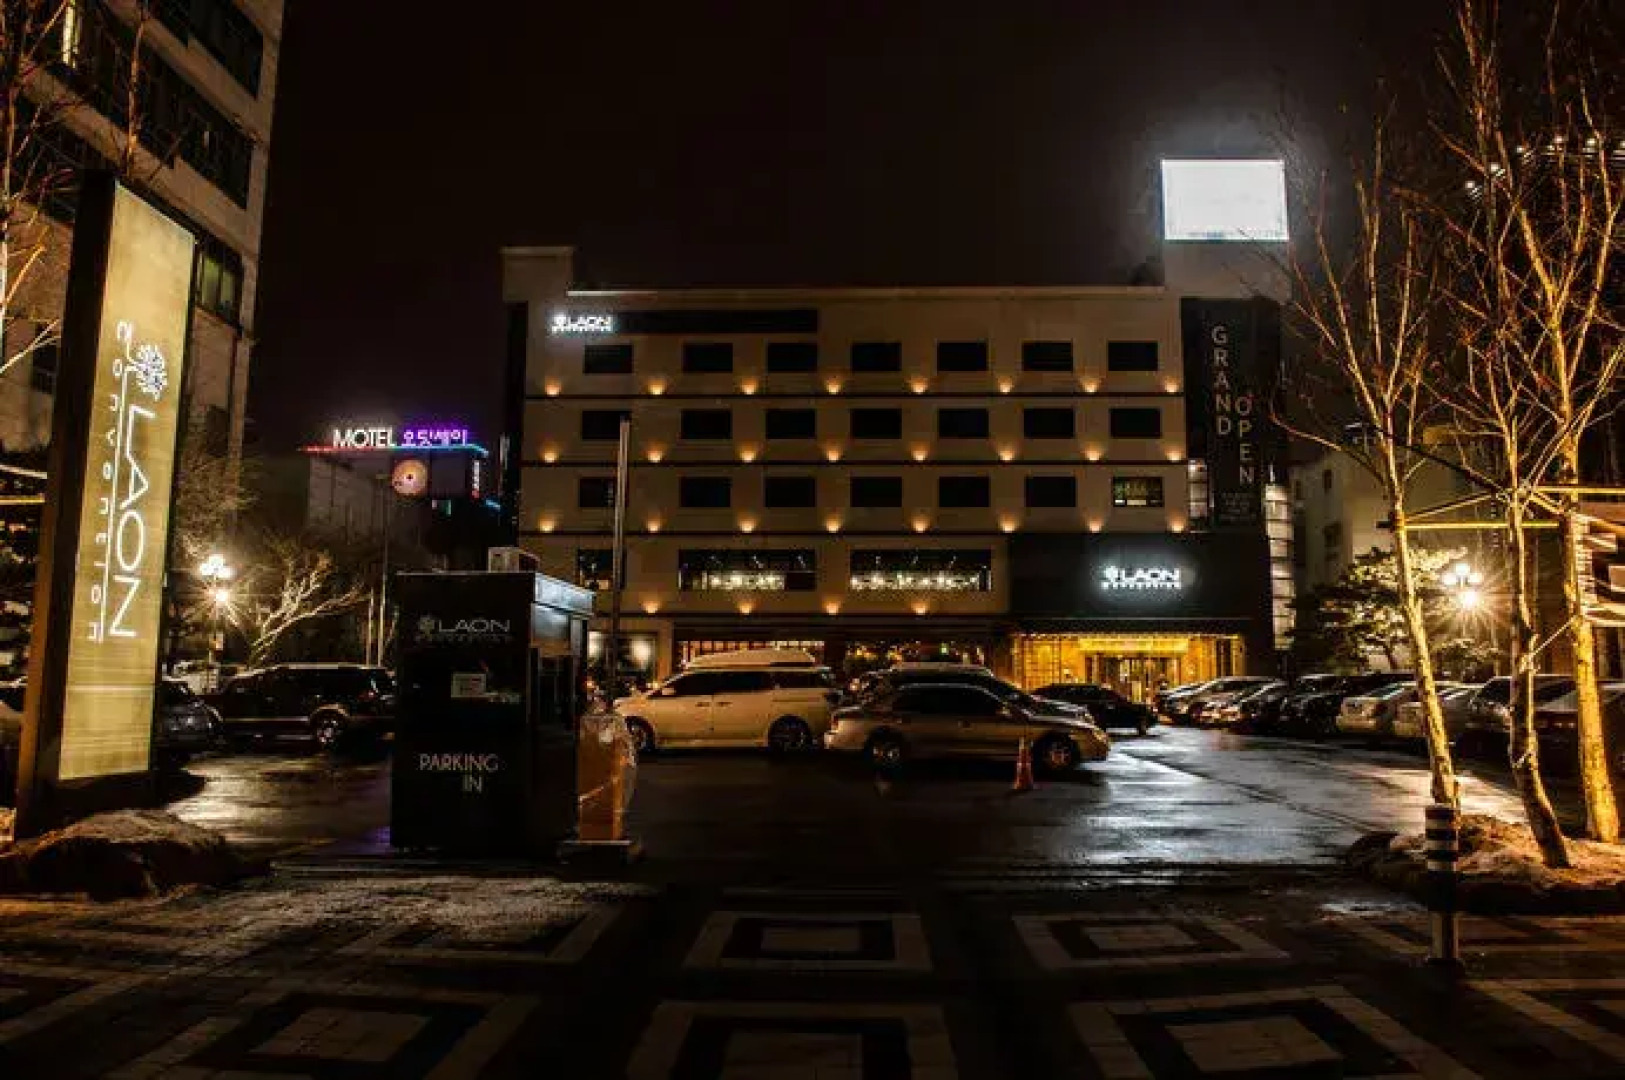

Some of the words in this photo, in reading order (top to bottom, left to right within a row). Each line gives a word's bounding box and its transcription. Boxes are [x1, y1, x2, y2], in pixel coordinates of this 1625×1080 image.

[1211, 325, 1232, 435] GRAND
[333, 427, 396, 447] MOTEL
[1234, 396, 1254, 484] OPEN
[109, 404, 156, 638] LAON
[1121, 567, 1181, 581] LAON
[438, 619, 511, 632] LAON
[419, 753, 499, 772] PARKING
[463, 774, 482, 793] IN
